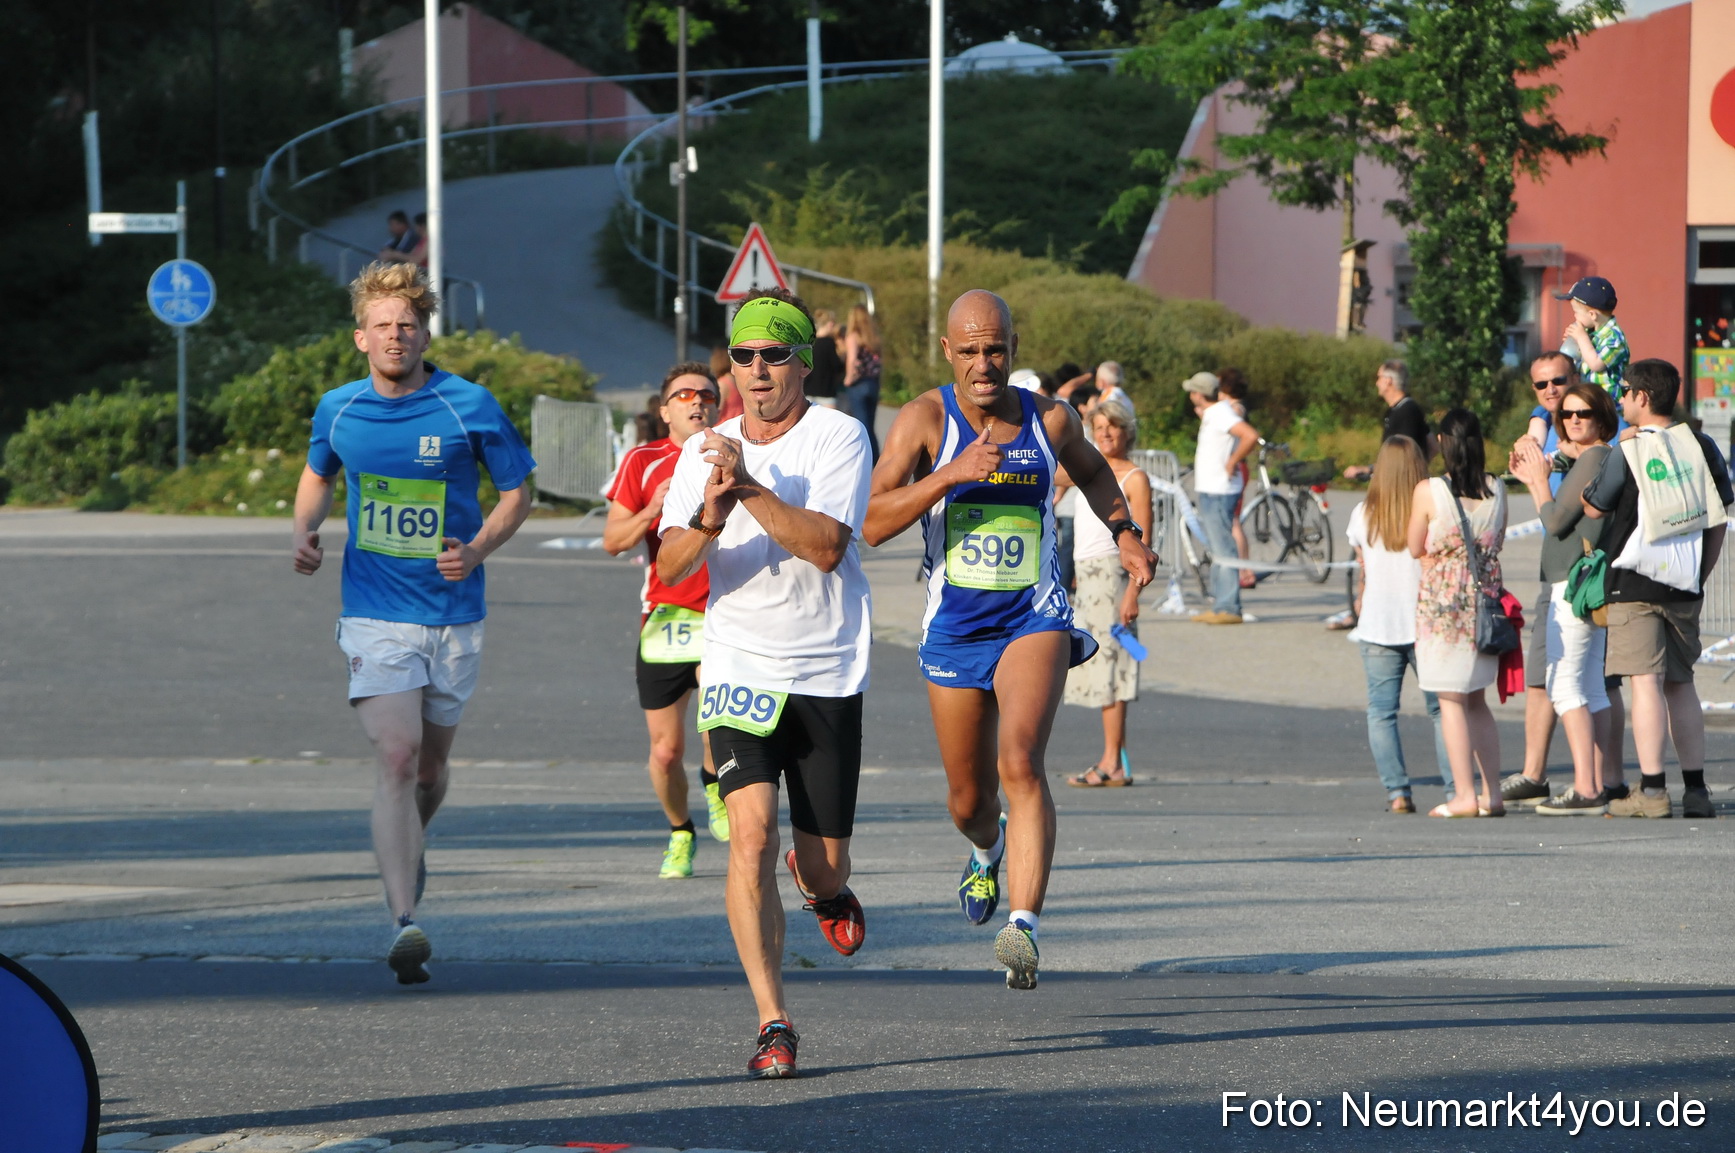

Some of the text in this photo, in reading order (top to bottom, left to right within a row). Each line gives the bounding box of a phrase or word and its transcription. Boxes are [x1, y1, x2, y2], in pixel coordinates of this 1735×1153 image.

[1008, 449, 1038, 459] HEITEC
[988, 472, 1038, 485] QUELLE
[363, 500, 439, 538] 1169
[961, 533, 1025, 569] 599
[661, 622, 692, 646] 15
[701, 682, 777, 723] 5099
